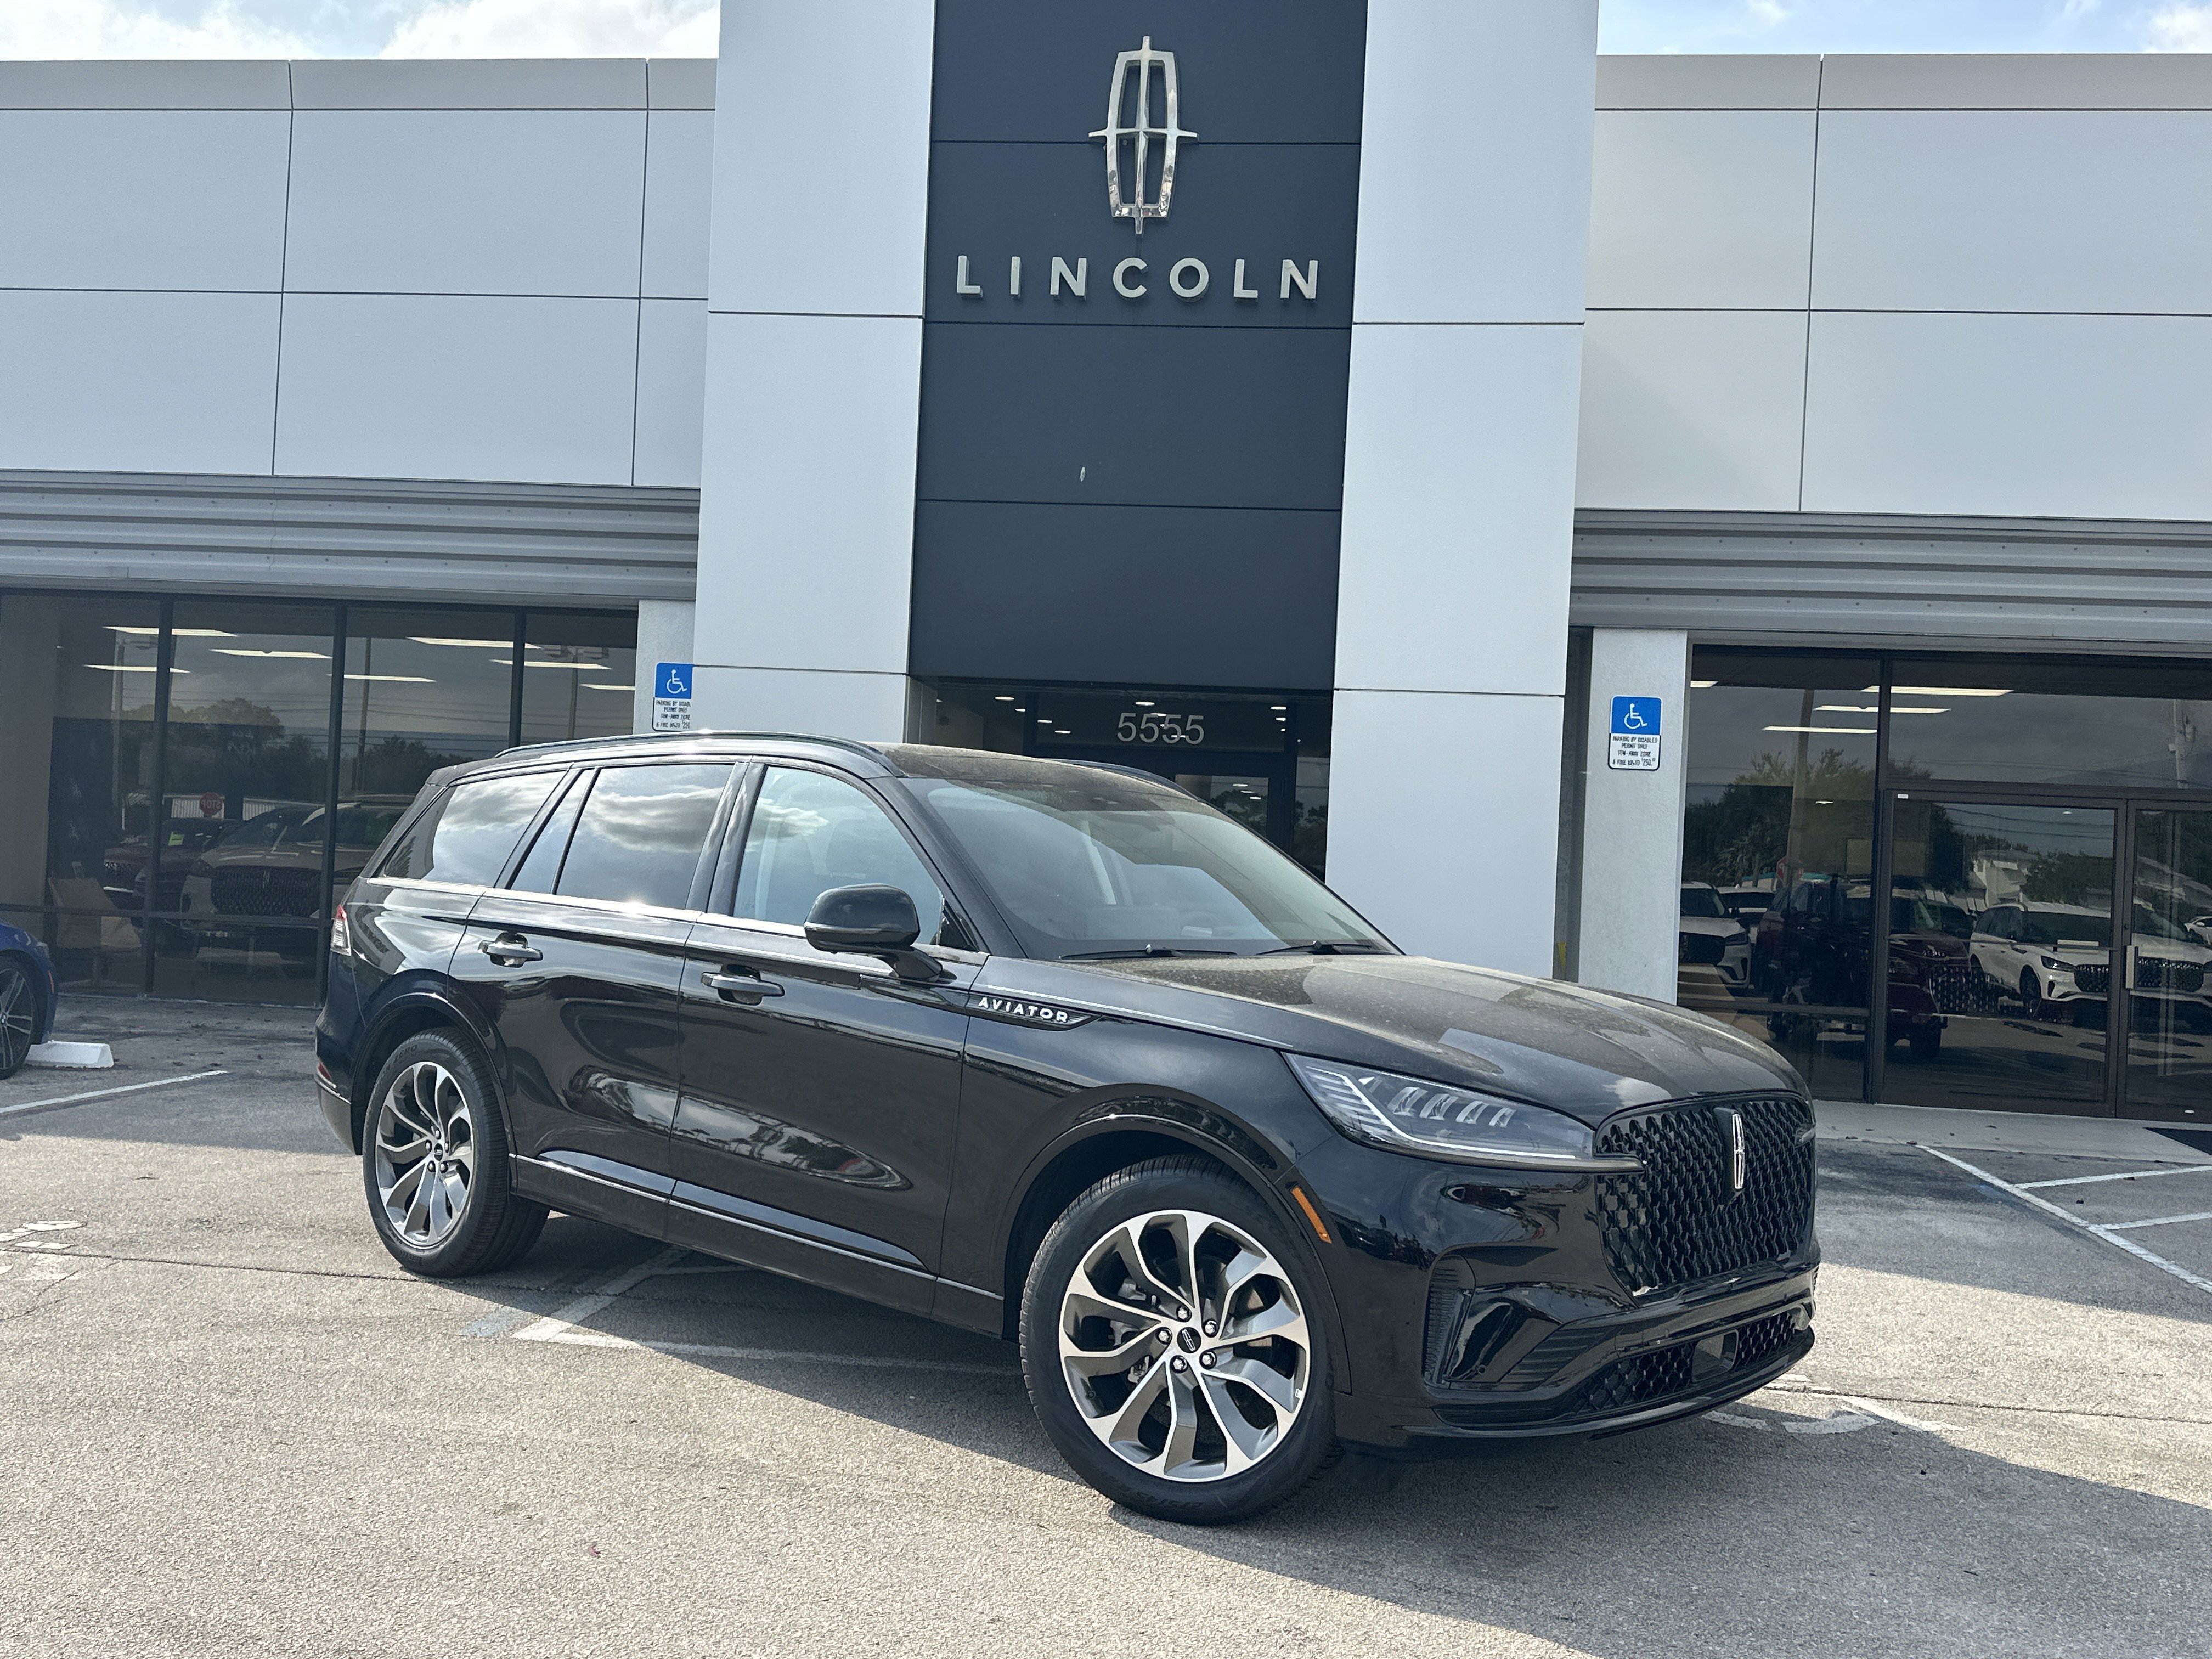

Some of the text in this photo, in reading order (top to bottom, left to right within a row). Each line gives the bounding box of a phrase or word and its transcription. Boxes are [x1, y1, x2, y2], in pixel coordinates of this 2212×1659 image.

[956, 255, 1318, 300] LINCOLN
[1117, 713, 1204, 744] 5555
[978, 997, 1069, 1023] AVIATOR
